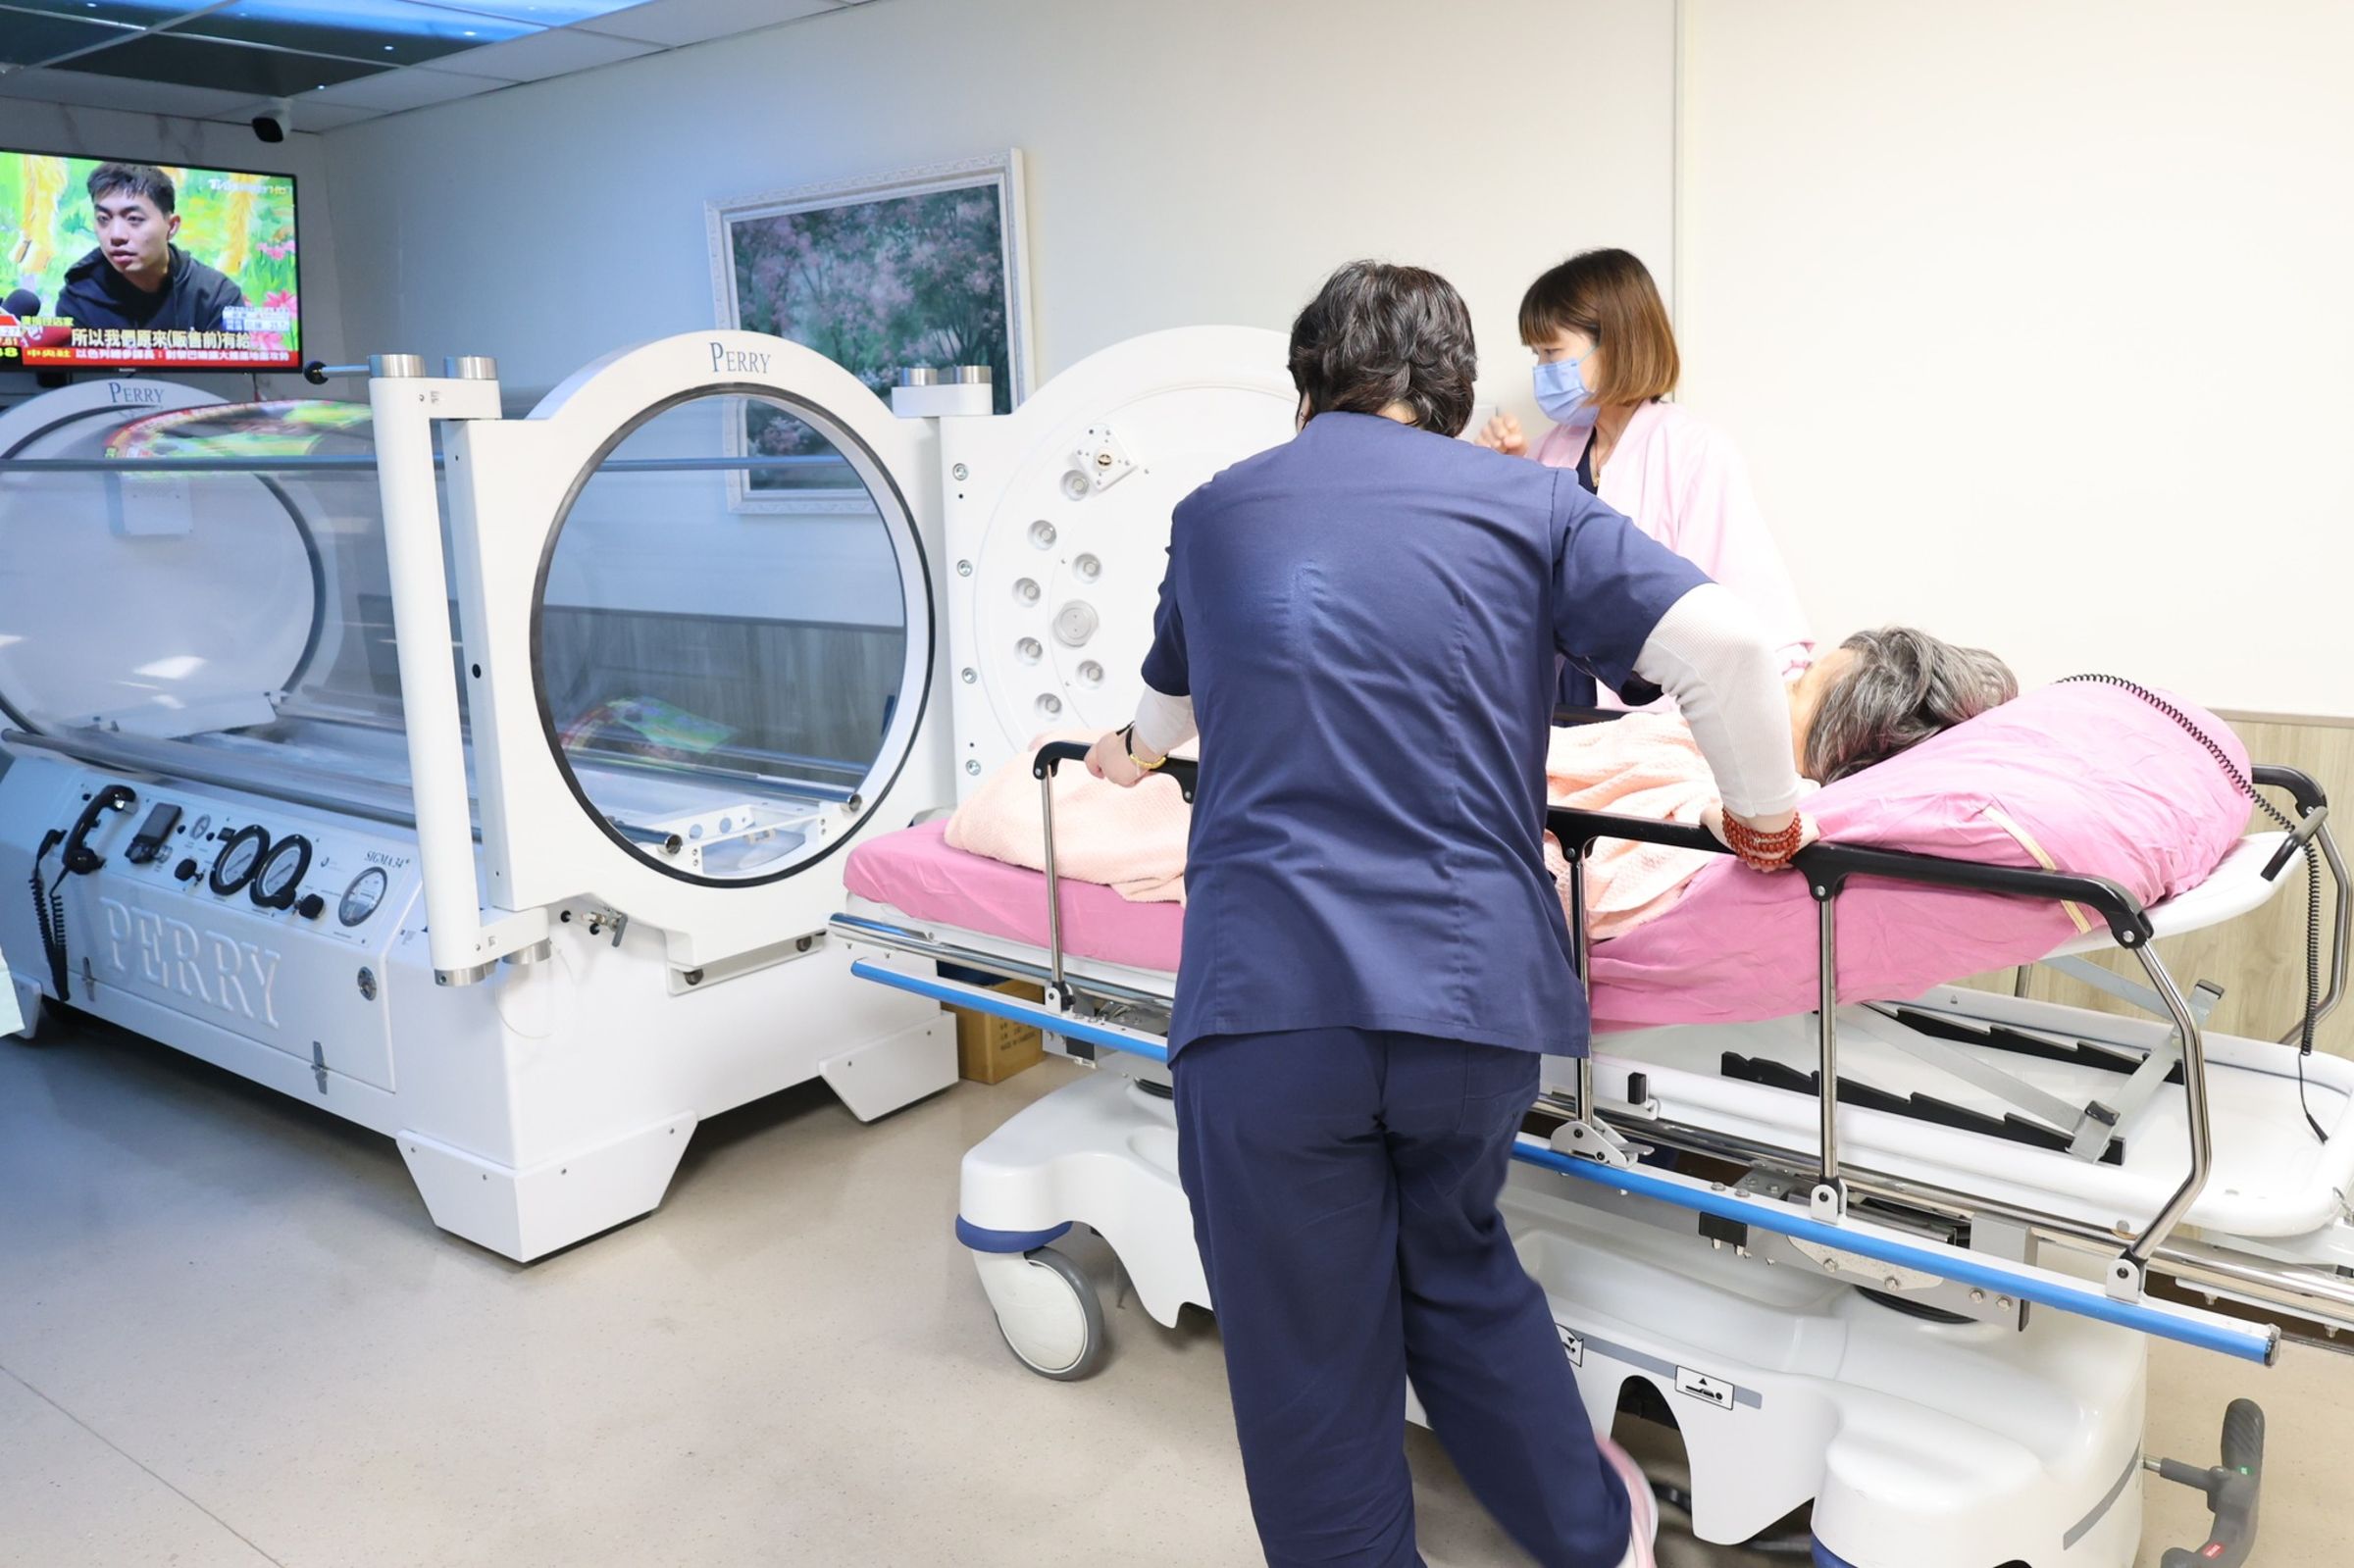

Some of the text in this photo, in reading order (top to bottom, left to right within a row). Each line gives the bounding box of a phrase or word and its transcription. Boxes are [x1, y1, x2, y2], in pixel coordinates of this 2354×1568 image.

[26, 348, 72, 358] 中央社
[364, 850, 393, 867] SIGMA
[99, 896, 282, 1030] PERRY
